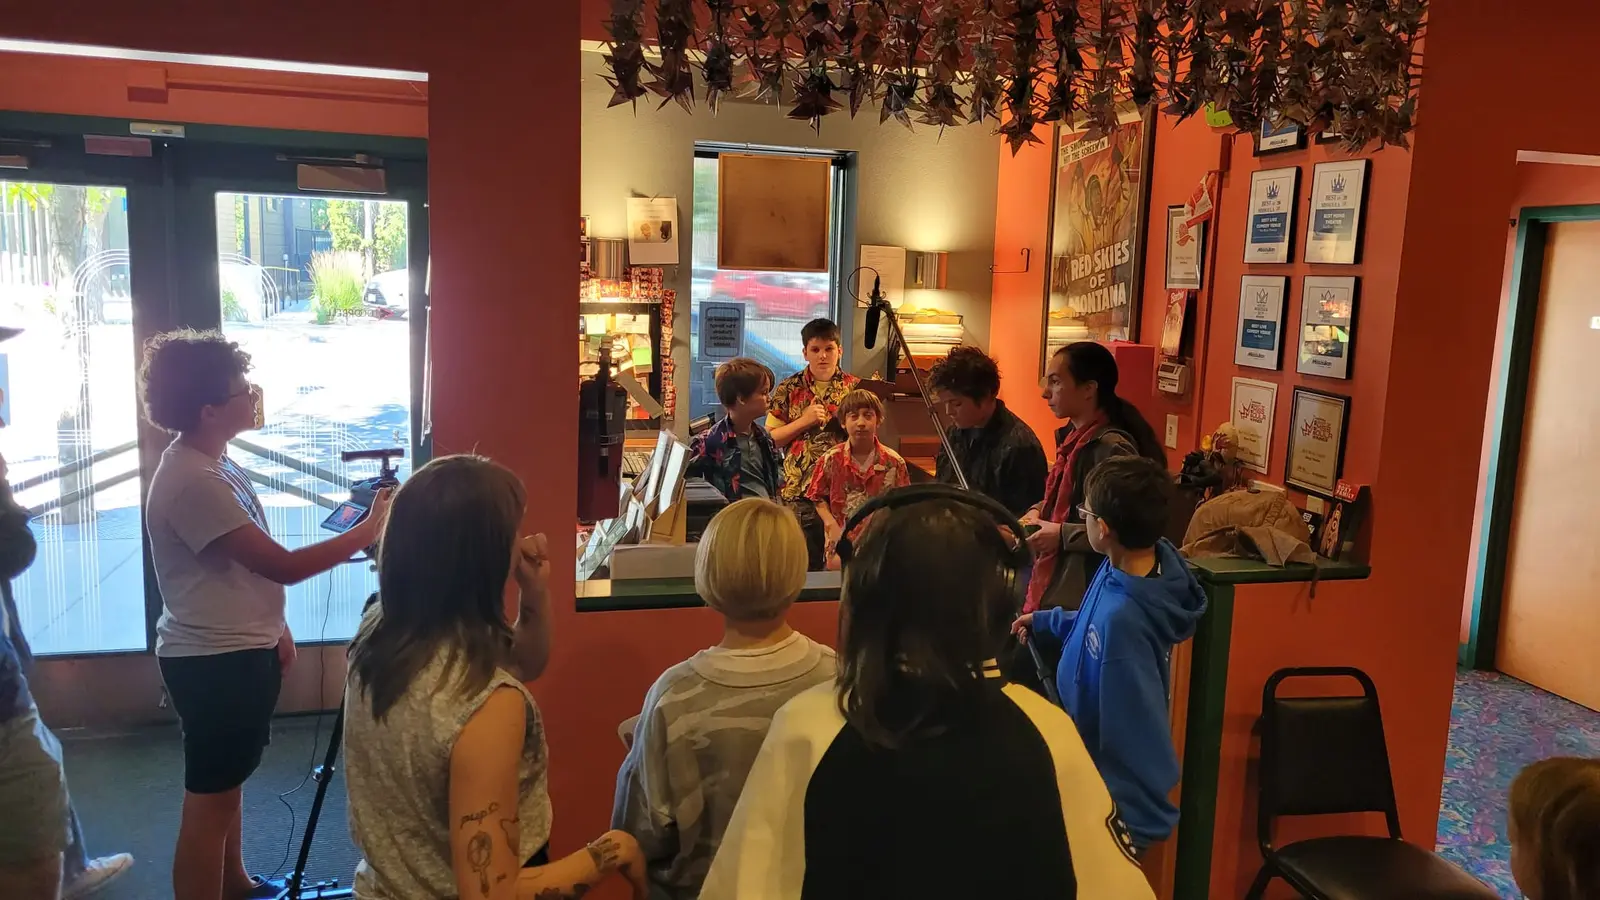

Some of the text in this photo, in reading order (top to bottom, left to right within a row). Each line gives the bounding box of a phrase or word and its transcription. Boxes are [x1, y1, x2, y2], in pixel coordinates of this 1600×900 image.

[1061, 145, 1069, 155] THE
[1072, 151, 1080, 161] THE
[1081, 142, 1100, 157] SCREEN
[1071, 239, 1129, 281] RED SKIES
[1089, 272, 1106, 289] OF
[1068, 281, 1127, 317] MONTANA
